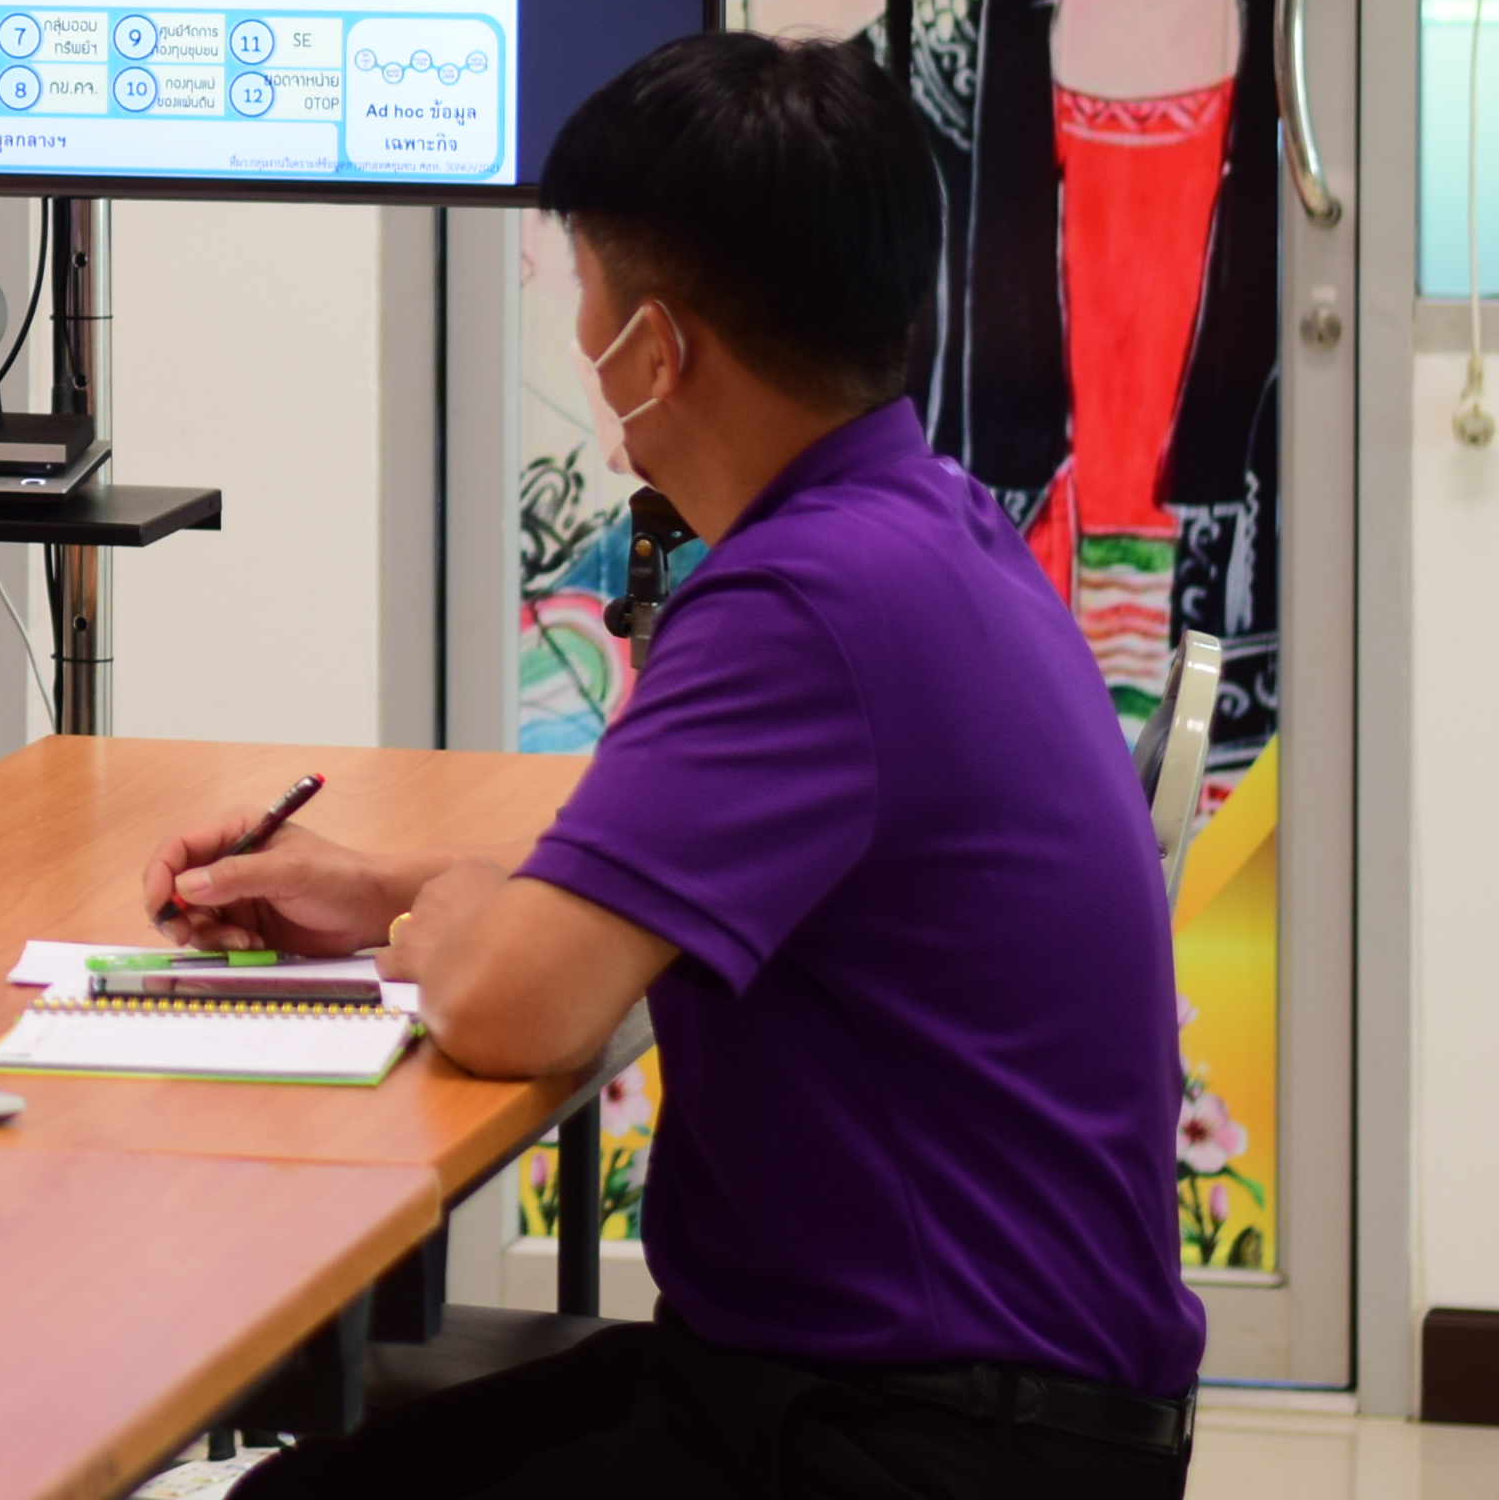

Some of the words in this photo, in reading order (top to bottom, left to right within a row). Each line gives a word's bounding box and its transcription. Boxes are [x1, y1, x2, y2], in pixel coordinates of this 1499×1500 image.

[293, 32, 312, 47] SE
[304, 97, 339, 110] OTOP
[365, 104, 388, 118] Ad
[394, 104, 424, 118] hoc
[430, 99, 476, 126] ข้อมูล
[385, 132, 457, 151] เฉพาะกิจ
